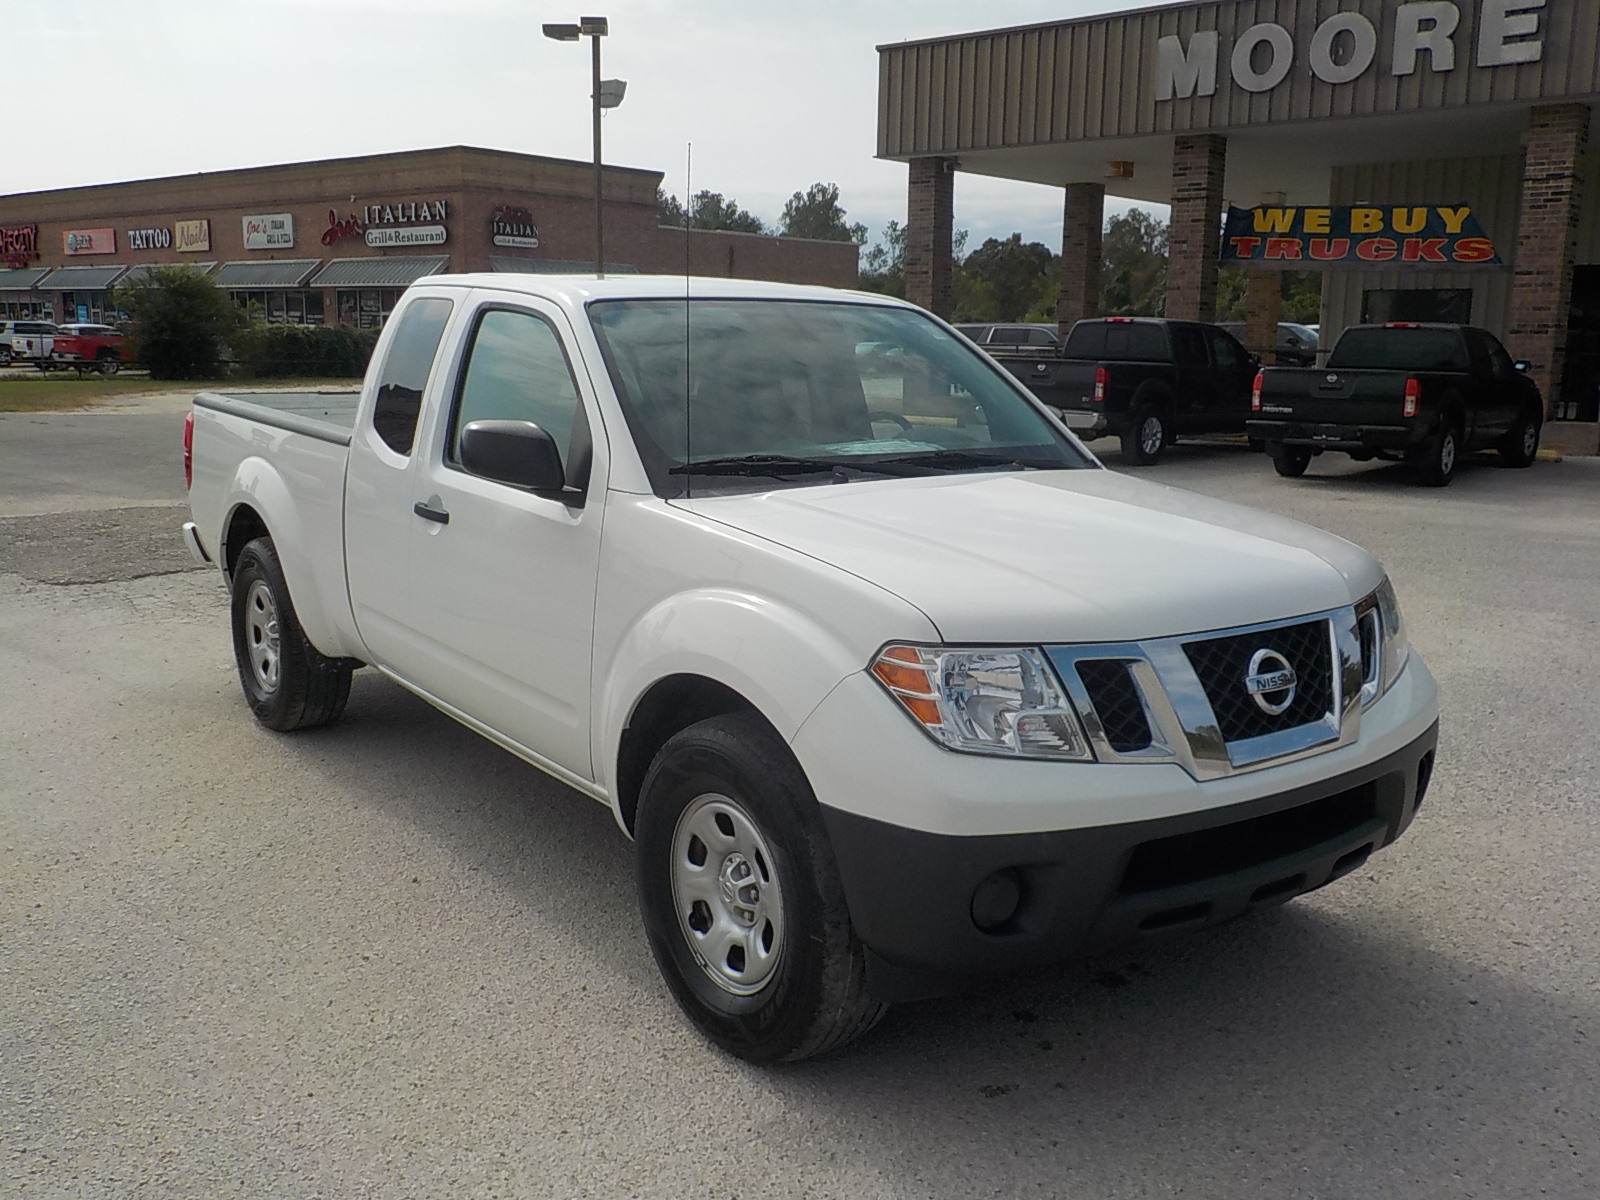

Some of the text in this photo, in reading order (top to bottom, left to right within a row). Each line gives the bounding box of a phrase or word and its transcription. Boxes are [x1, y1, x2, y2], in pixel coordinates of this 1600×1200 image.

[1155, 0, 1546, 101] MOORE
[364, 201, 447, 224] ITALIAN
[1252, 207, 1471, 234] WE BUY
[128, 229, 170, 249] TATTOO
[176, 221, 208, 249] Nails
[246, 219, 268, 244] Joe's
[493, 222, 538, 236] ITALIAN
[1229, 237, 1495, 263] TRUCKS
